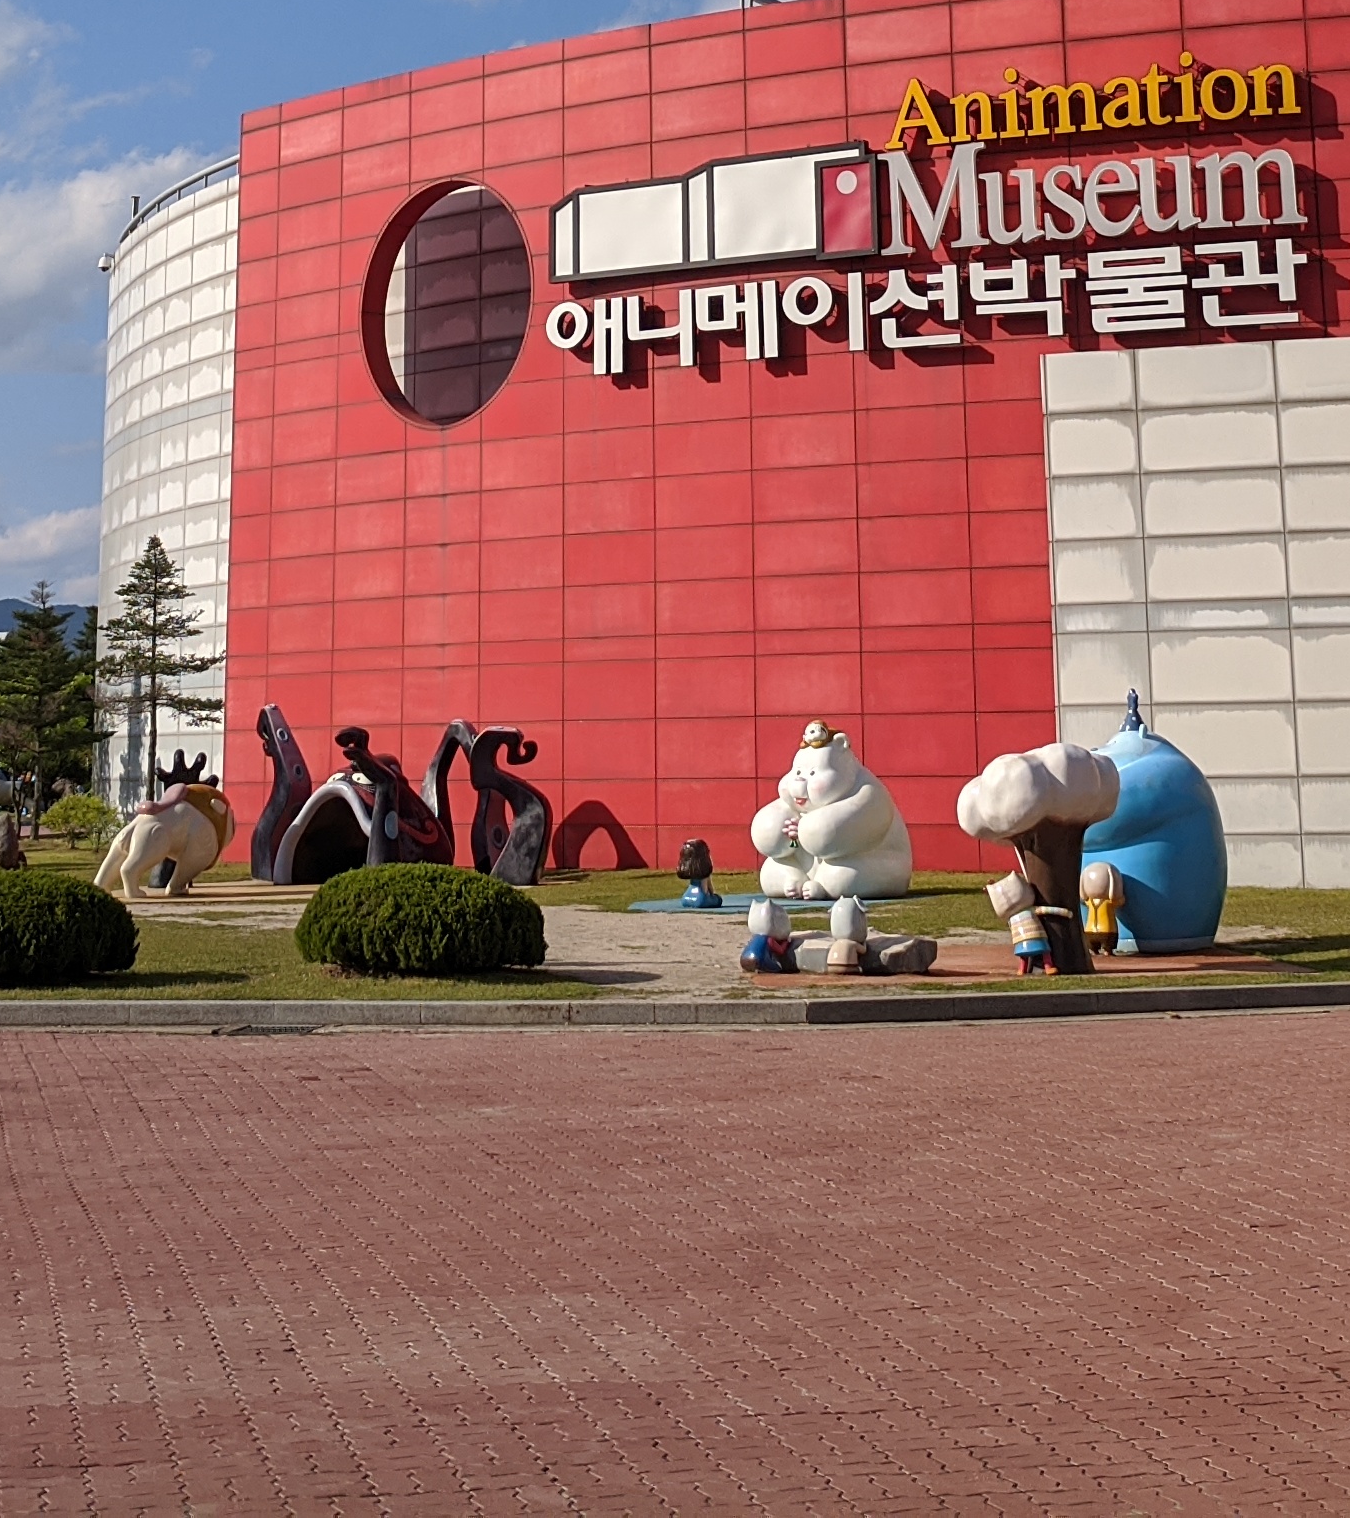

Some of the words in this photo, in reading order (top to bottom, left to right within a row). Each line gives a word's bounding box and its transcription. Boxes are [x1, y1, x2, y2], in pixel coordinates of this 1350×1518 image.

[885, 51, 1302, 150] Animation
[880, 143, 1308, 257] Museum
[545, 238, 1308, 376] 애니메이션박물관
